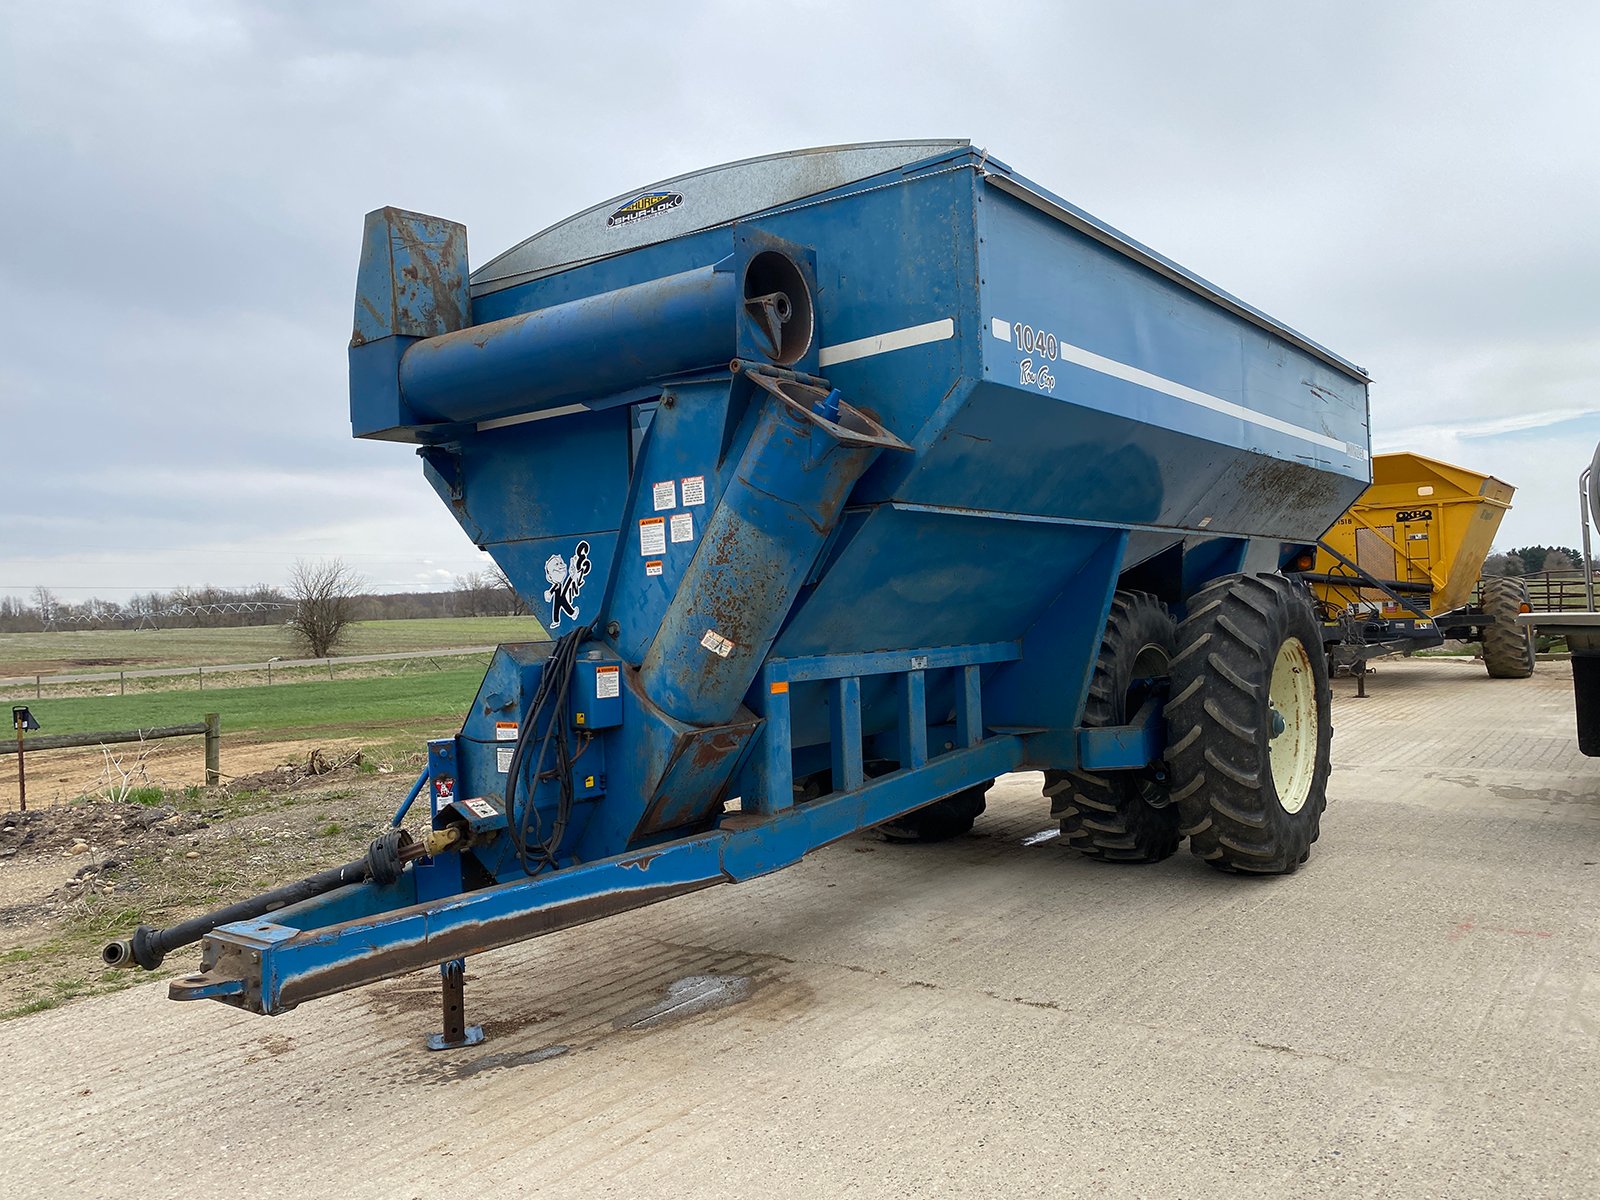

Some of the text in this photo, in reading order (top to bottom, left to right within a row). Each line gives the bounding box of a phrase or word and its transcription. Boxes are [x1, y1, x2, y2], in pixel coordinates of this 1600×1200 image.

[614, 201, 674, 224] SHUR-LOK
[1014, 322, 1057, 361] 1040
[1396, 510, 1432, 522] OXBO
